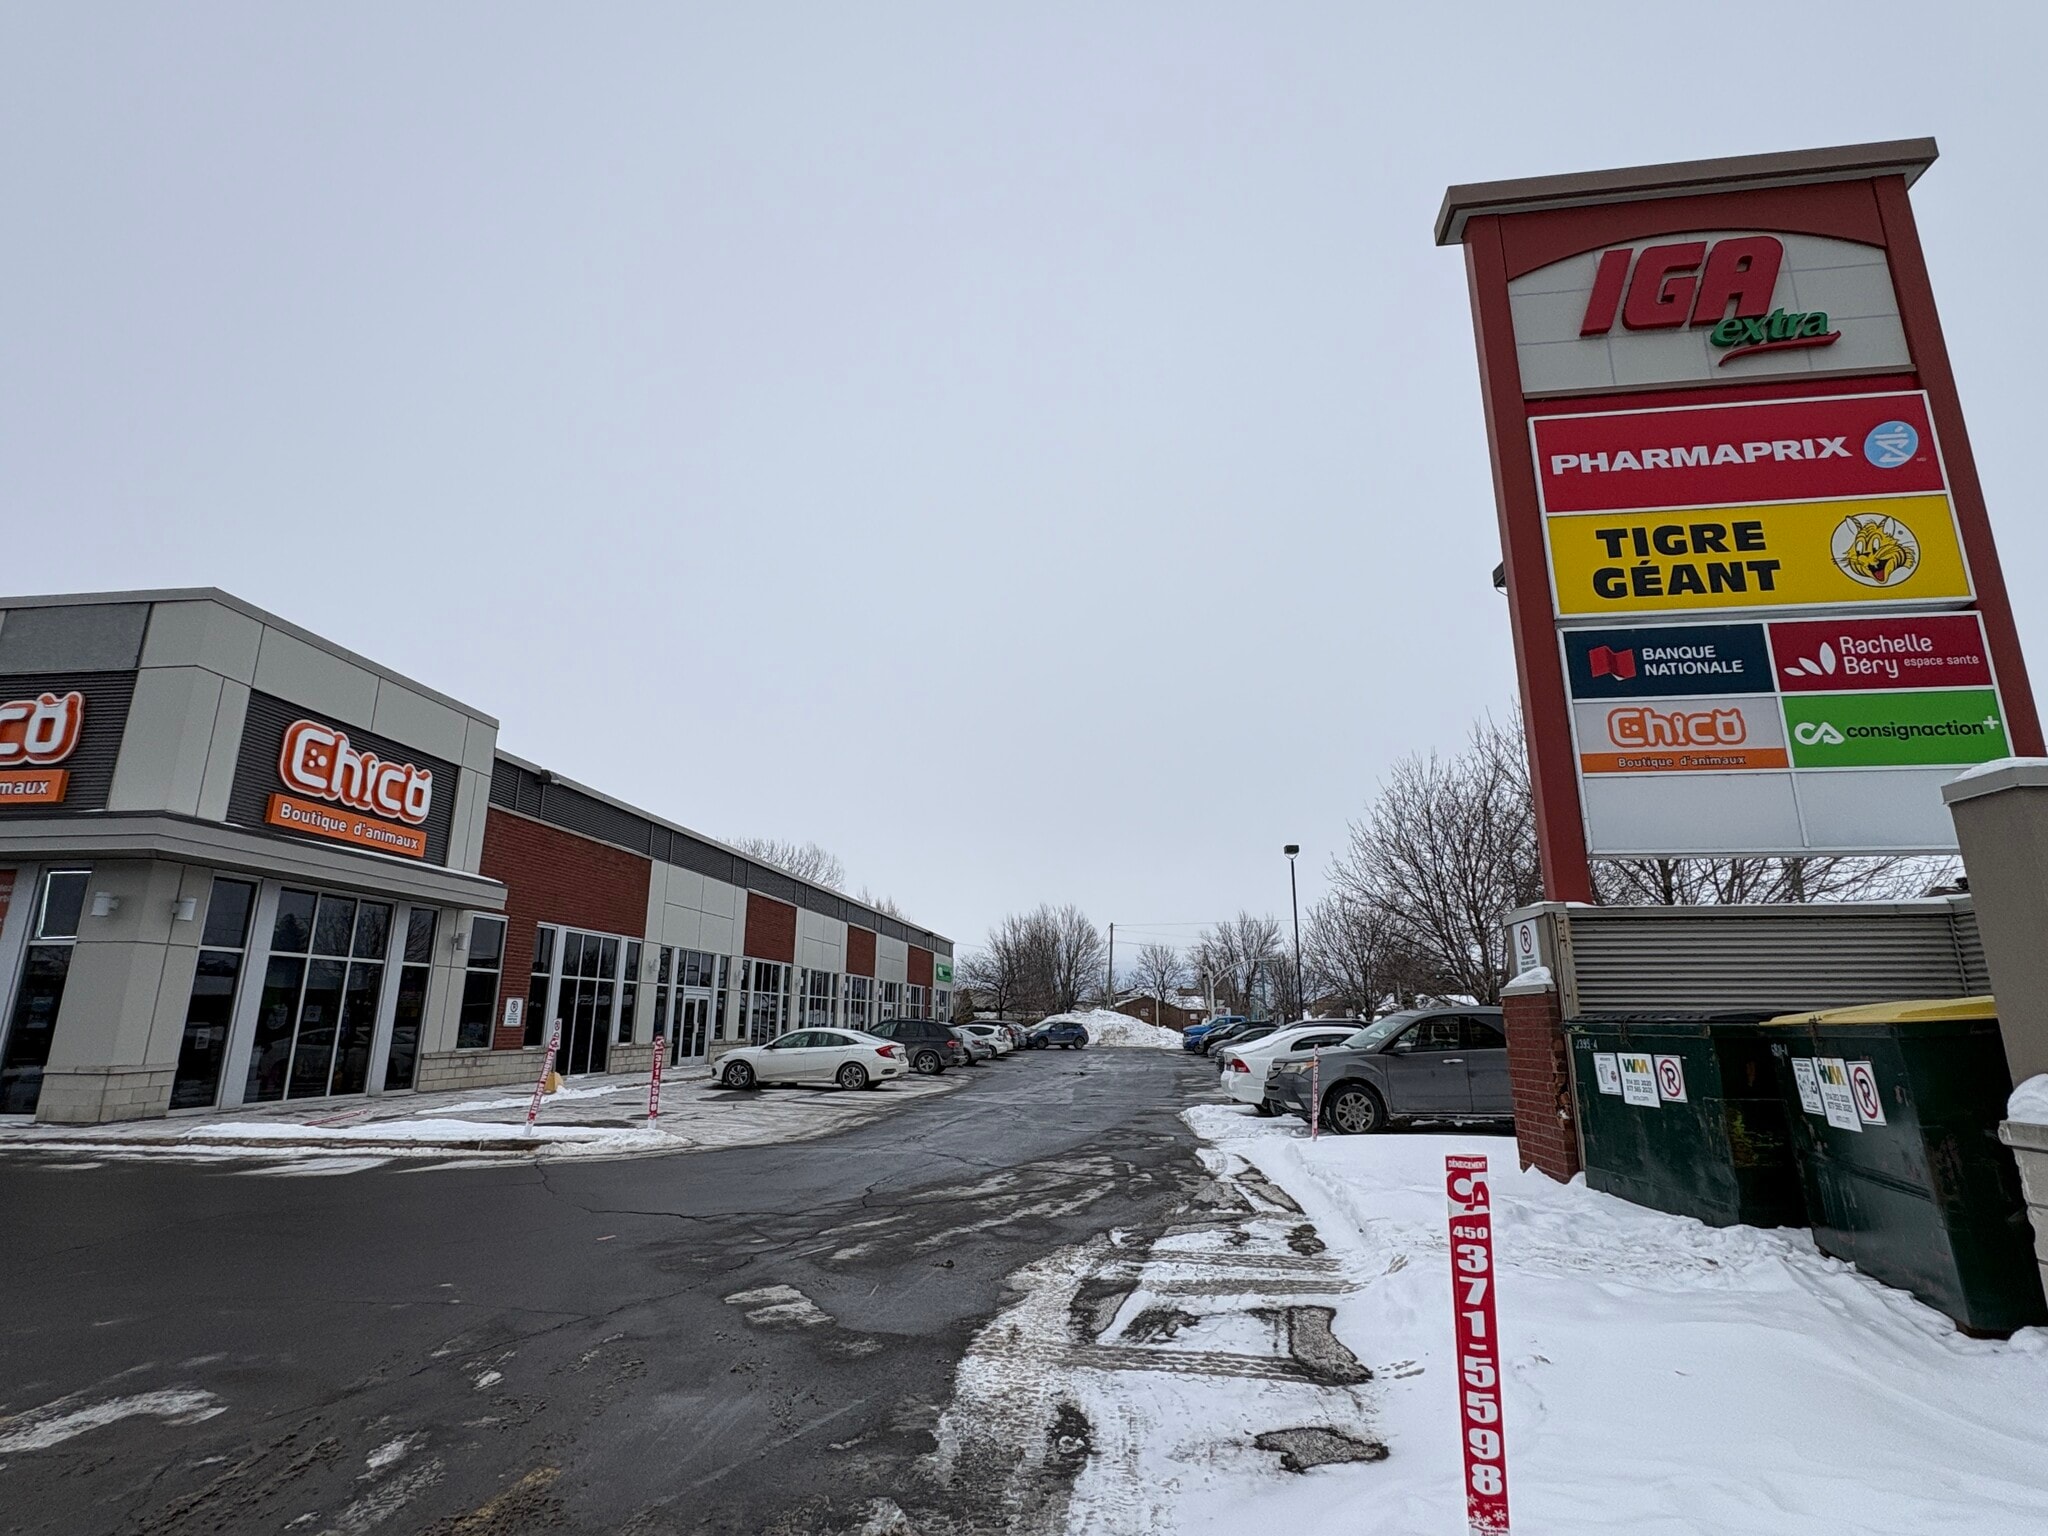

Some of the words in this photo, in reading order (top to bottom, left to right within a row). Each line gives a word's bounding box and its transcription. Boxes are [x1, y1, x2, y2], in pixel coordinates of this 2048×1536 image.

[1579, 236, 1783, 336] IGA
[1710, 307, 1829, 347] extra
[1551, 436, 1853, 475] PHARMAPRIX
[1595, 520, 1767, 559] TIGRE
[1592, 559, 1781, 599] GÉANT
[1642, 645, 1716, 660] BANQUE
[1839, 634, 1933, 654] Rachelle
[1644, 660, 1744, 676] NATIONALE
[1843, 656, 1899, 679] Béry
[1904, 656, 1943, 668] espace
[1609, 709, 1745, 746] Chico
[286, 723, 432, 821] Chico
[1618, 756, 1673, 768] Boutique
[1680, 755, 1745, 767] d'animaux
[280, 803, 347, 831] Boutique
[353, 823, 419, 850] d'animaux
[1453, 1225, 1489, 1240] 450
[1456, 1244, 1503, 1496] 371-5598
